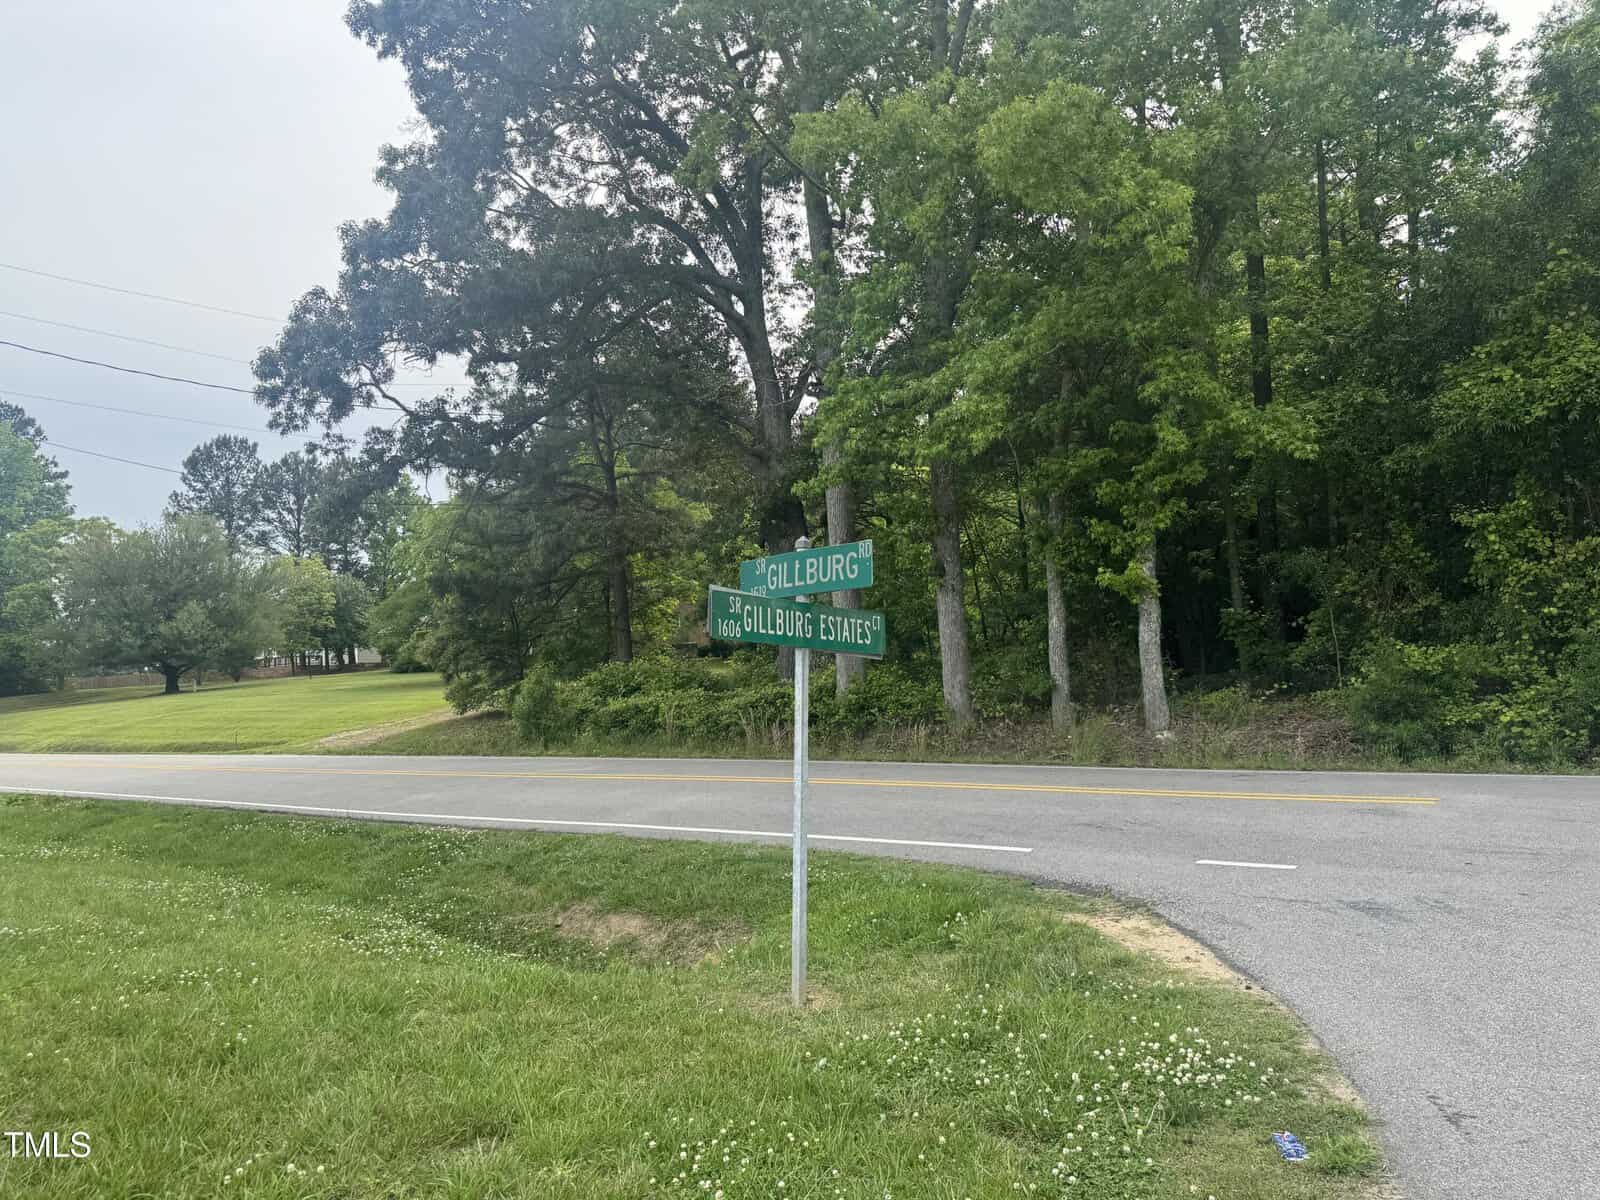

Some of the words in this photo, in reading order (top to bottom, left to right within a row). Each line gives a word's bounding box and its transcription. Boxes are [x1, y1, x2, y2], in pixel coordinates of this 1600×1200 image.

[755, 558, 766, 575] SR
[767, 552, 858, 590] GILLBURG
[859, 543, 871, 559] RD
[718, 618, 742, 638] 1606
[729, 596, 742, 614] SR
[743, 605, 812, 639] GILLBURG
[820, 614, 872, 645] ESTATES
[872, 615, 881, 631] CT
